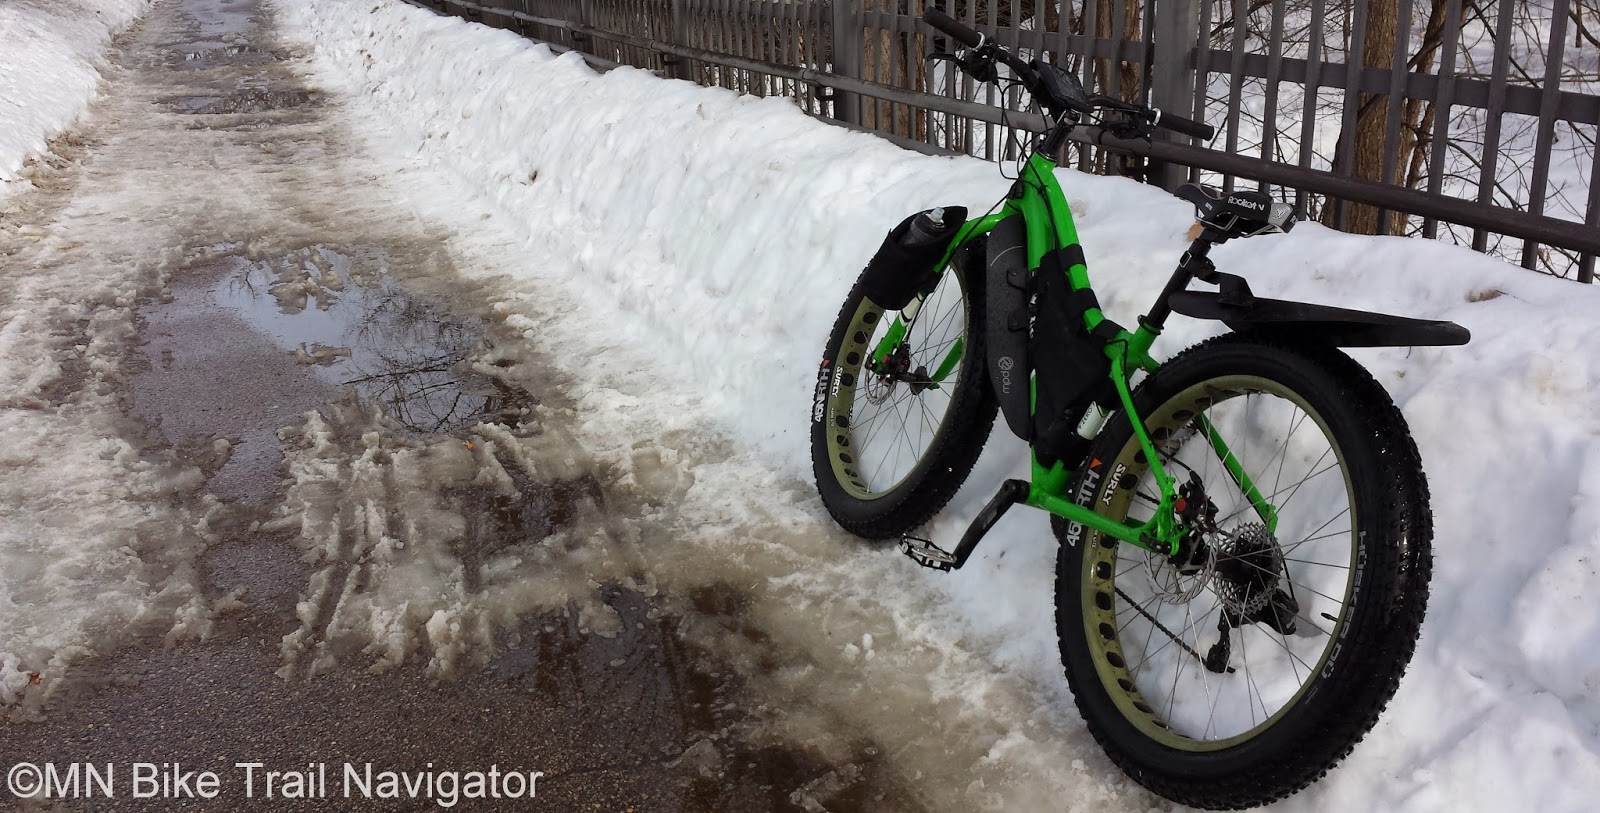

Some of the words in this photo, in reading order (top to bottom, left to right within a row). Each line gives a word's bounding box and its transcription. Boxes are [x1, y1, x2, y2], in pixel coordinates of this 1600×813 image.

[815, 368, 830, 422] 45NRTH
[831, 366, 843, 397] SURLY
[1000, 371, 1011, 394] pdw
[1102, 463, 1127, 506] SURLY
[1066, 469, 1100, 547] 45RTH
